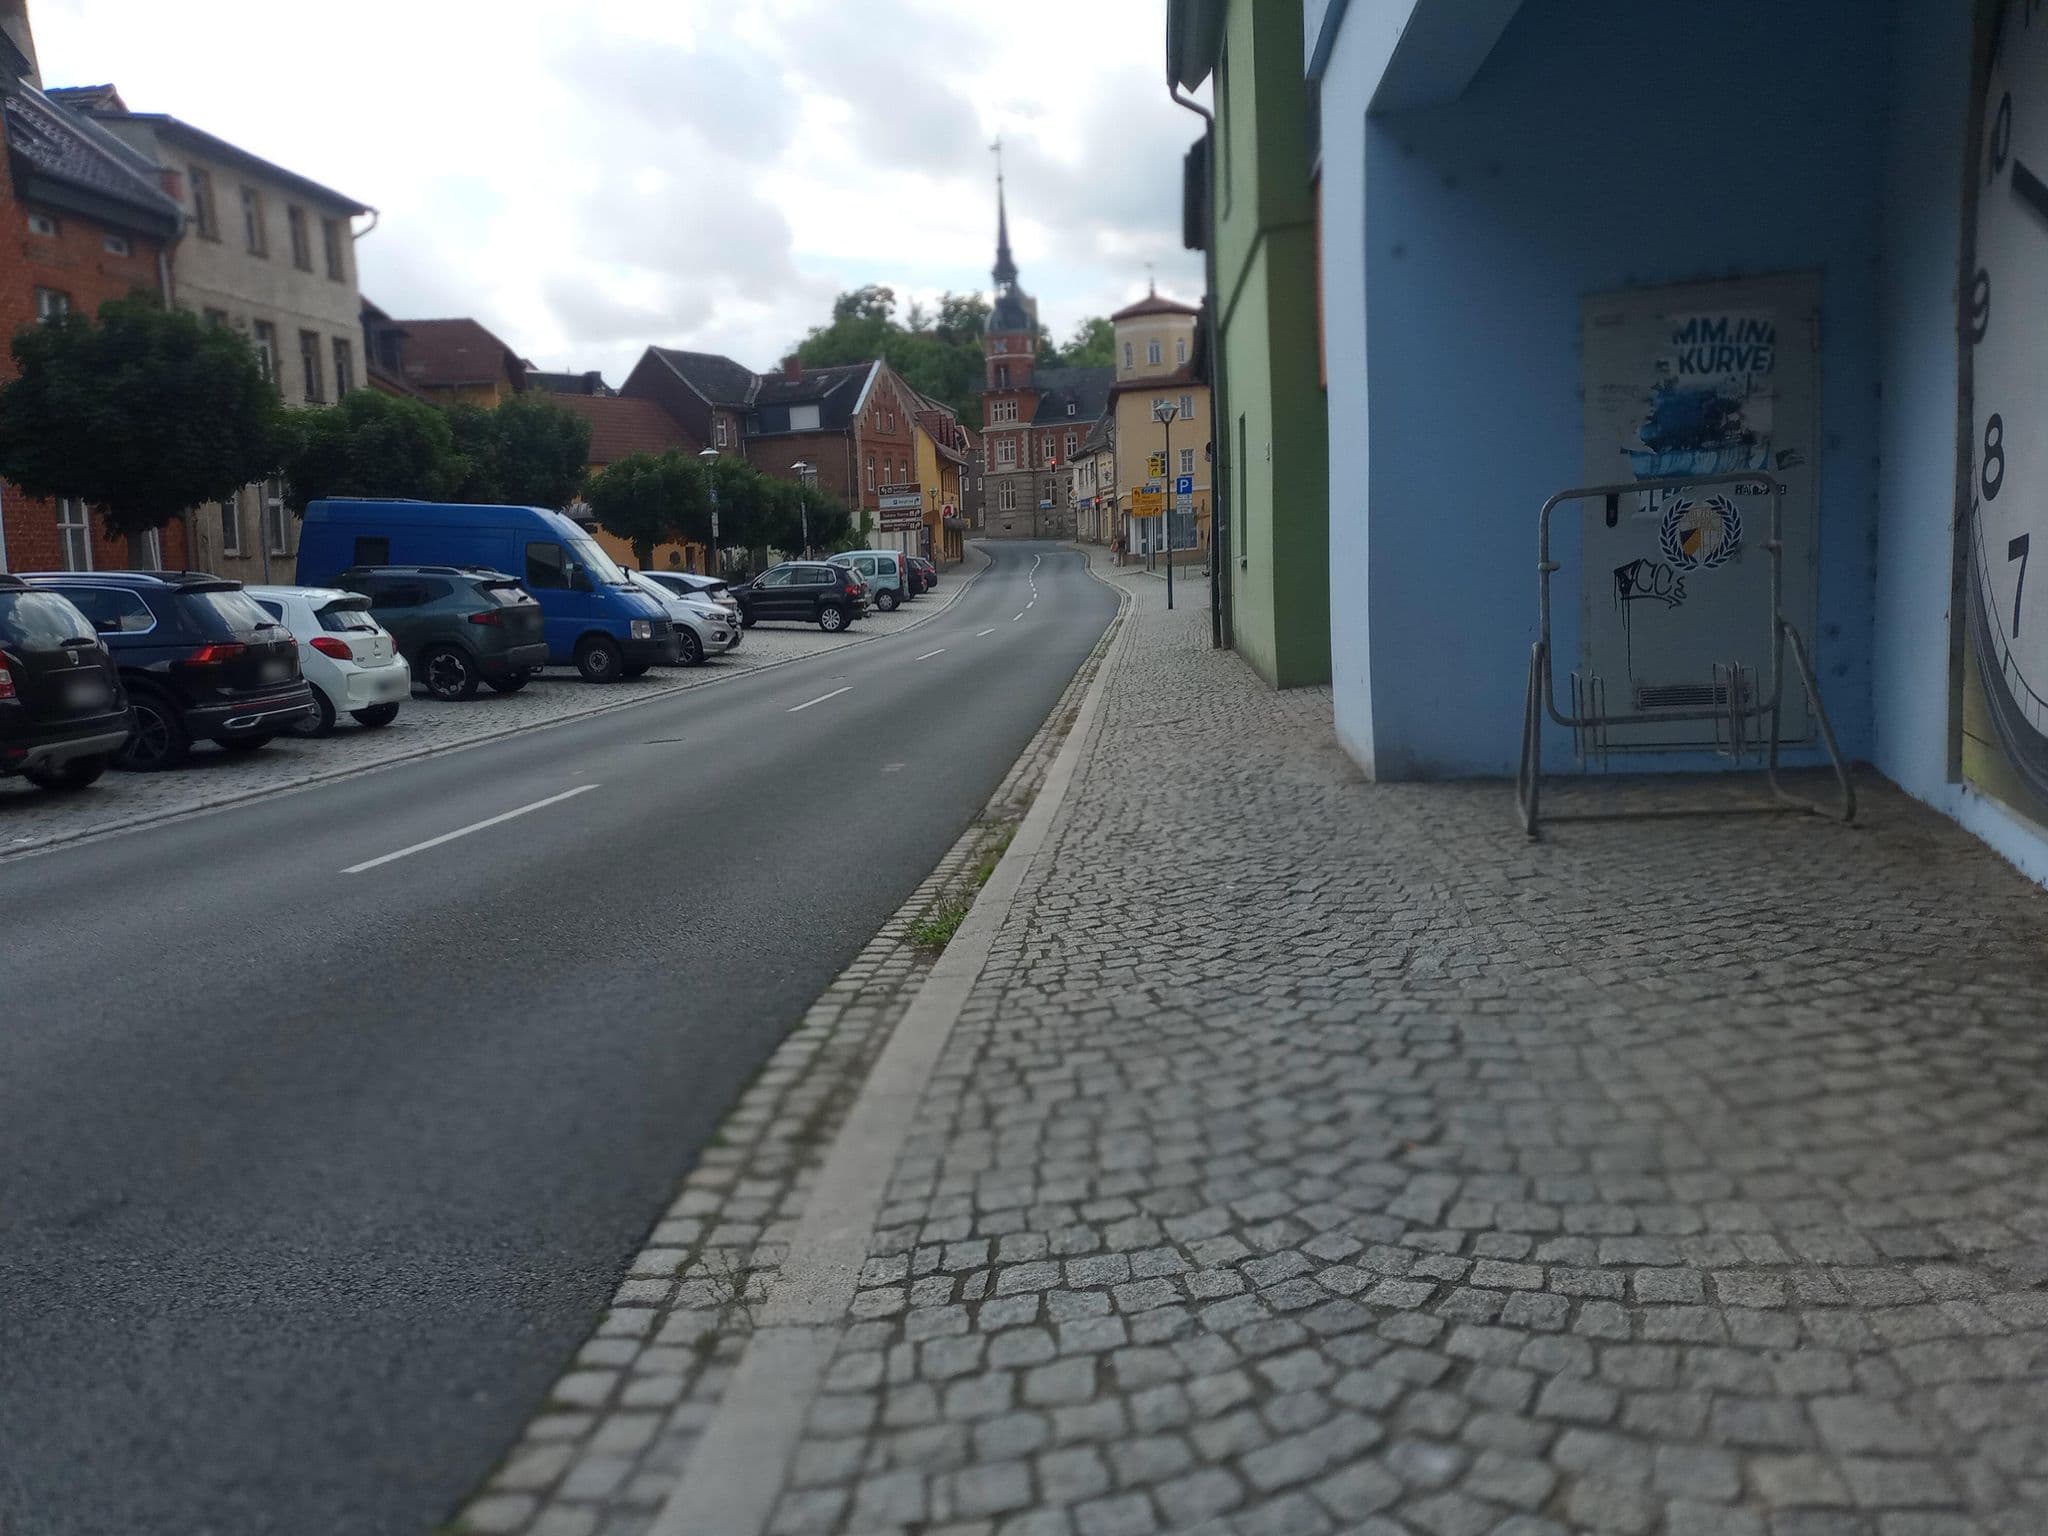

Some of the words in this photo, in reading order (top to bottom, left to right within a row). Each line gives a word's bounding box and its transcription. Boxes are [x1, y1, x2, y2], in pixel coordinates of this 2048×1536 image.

[1180, 479, 1189, 493] P
[1981, 412, 2004, 501] 8
[2008, 533, 2030, 640] 7
